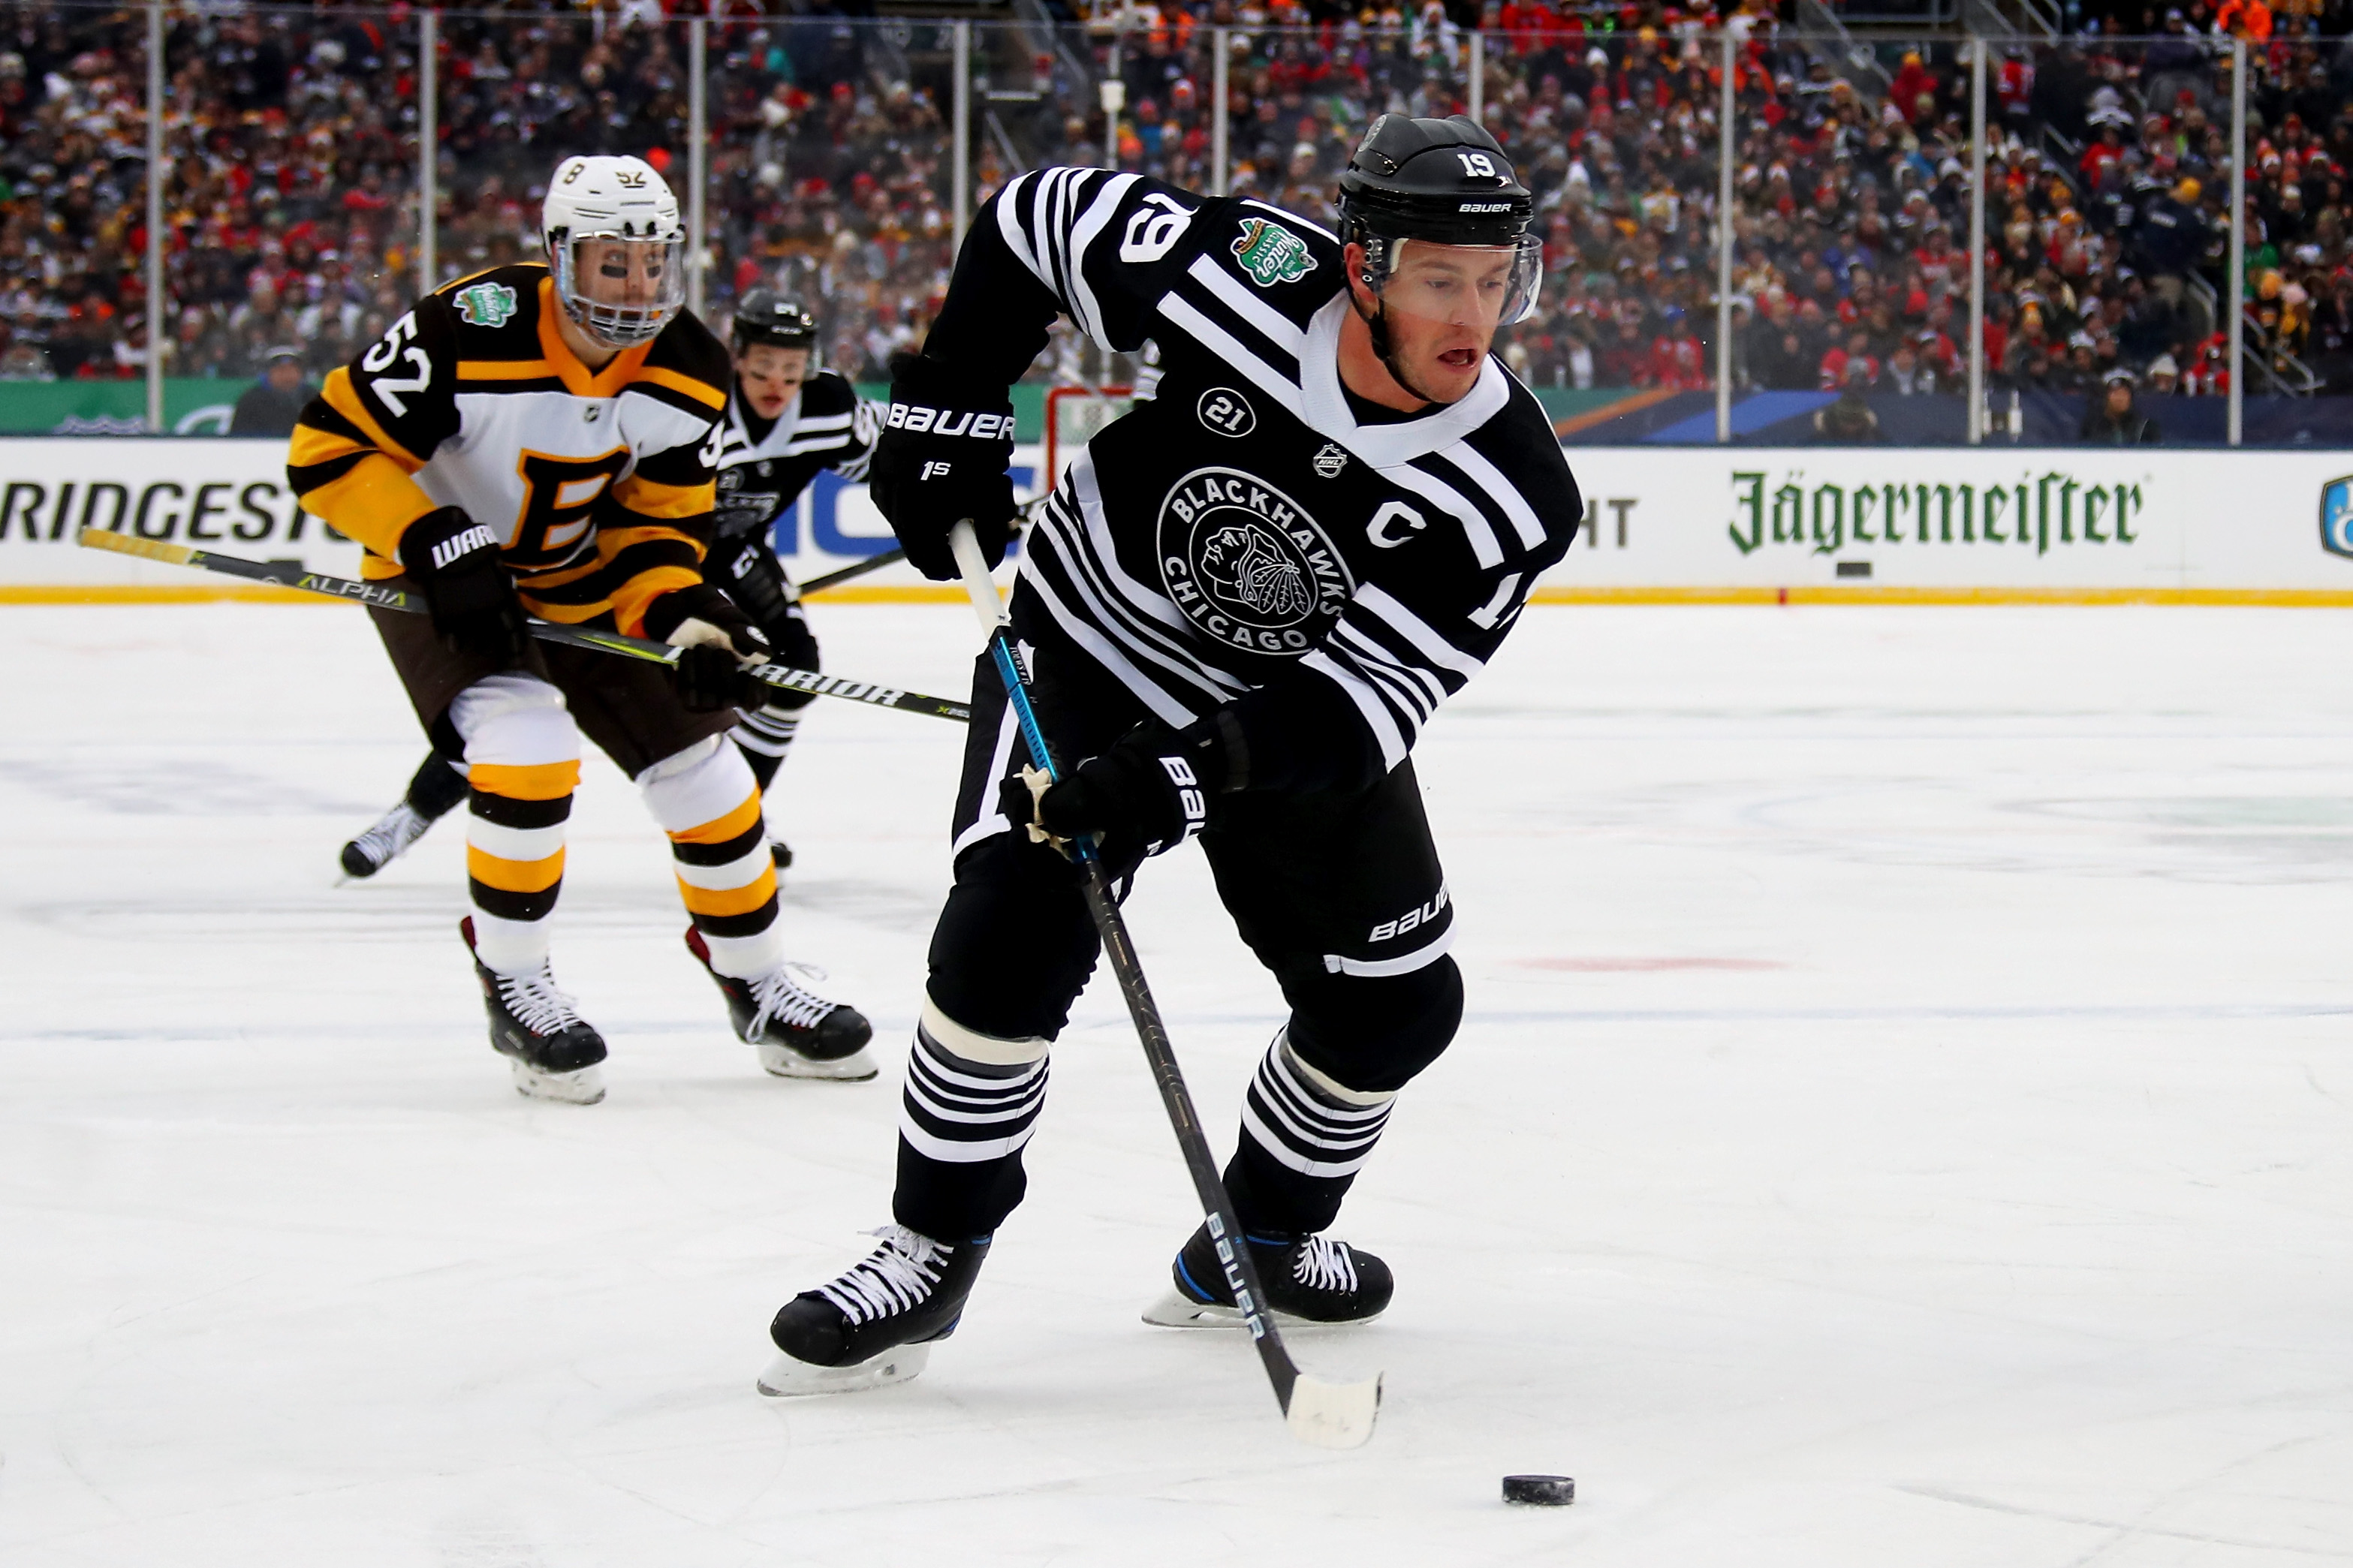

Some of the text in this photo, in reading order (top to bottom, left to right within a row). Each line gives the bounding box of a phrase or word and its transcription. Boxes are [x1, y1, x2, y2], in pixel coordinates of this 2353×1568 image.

[563, 163, 585, 185] B
[615, 170, 648, 185] 52
[1457, 153, 1497, 177] 19
[1458, 203, 1513, 213] BAUER
[1119, 192, 1201, 263] 19
[1252, 230, 1282, 263] CLASSIC
[1254, 230, 1301, 278] Winter
[362, 309, 432, 419] 52
[887, 402, 1016, 440] BAUER
[1204, 396, 1246, 432] 21
[1317, 458, 1340, 466] NHL
[1365, 501, 1427, 549] C
[1171, 477, 1346, 618] BLACKHAWKS
[297, 573, 406, 607] ALPHA
[1164, 555, 1308, 650] CHICAGO
[1205, 1210, 1266, 1340] BAUER
